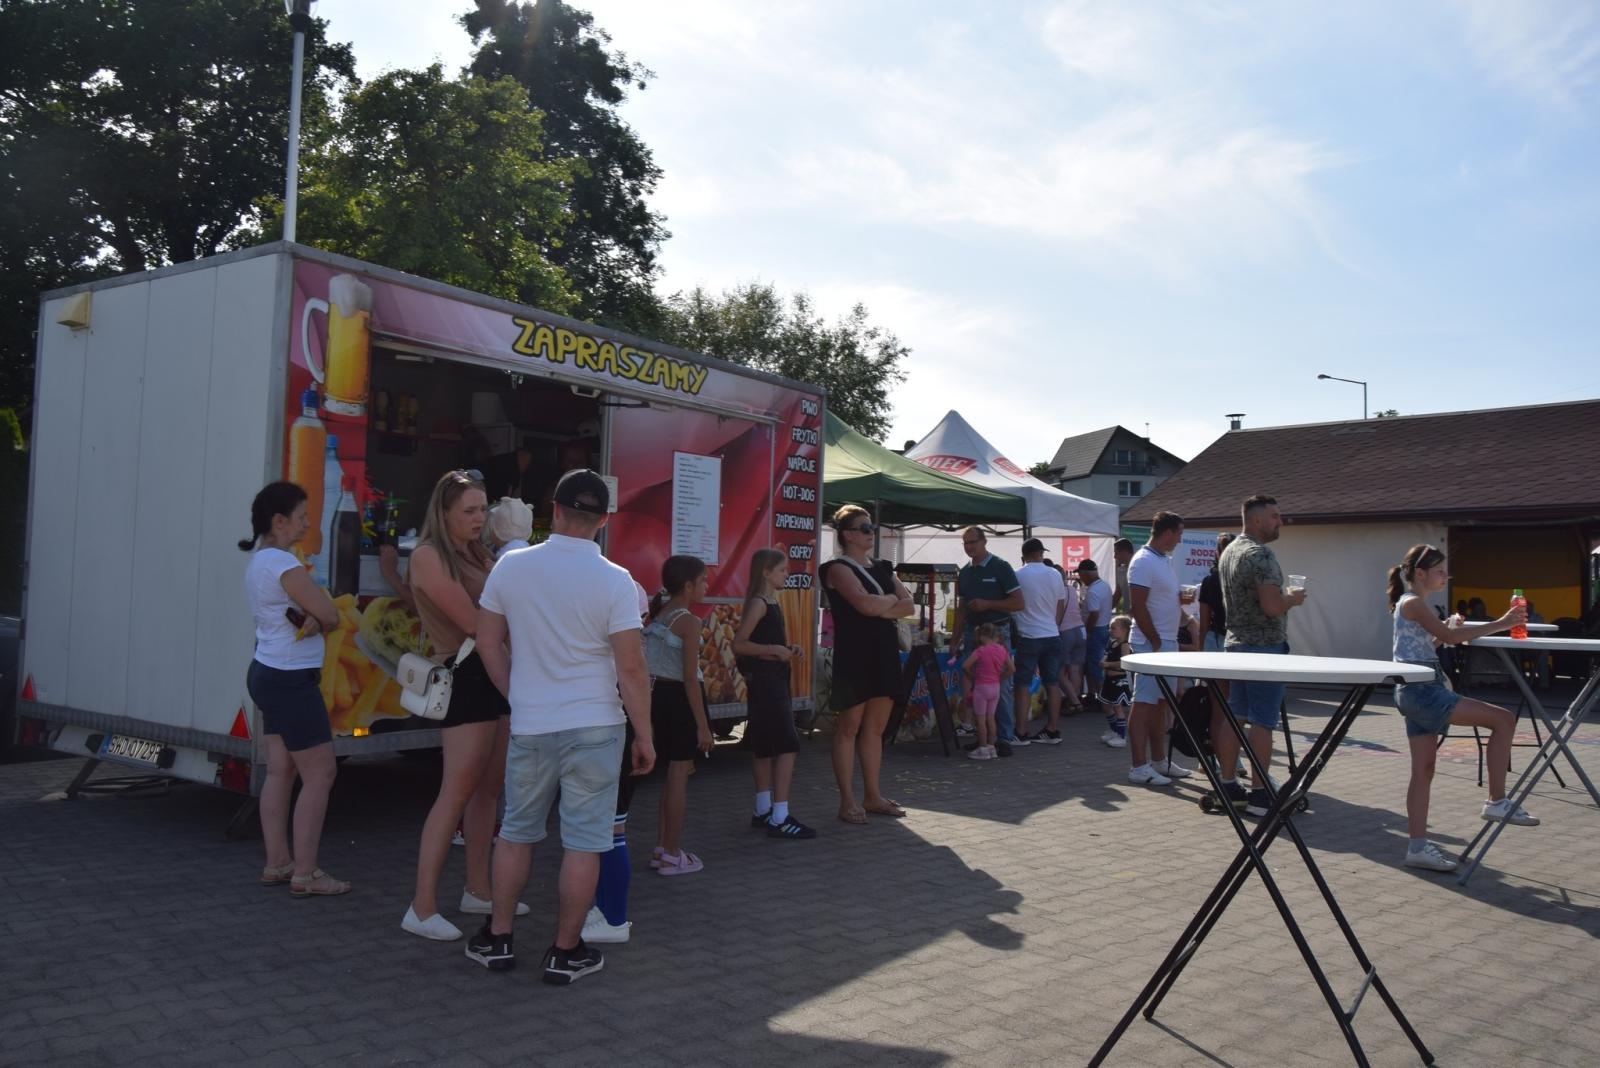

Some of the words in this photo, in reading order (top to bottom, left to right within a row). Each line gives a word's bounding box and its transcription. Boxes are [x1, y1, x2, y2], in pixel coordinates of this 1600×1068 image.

[512, 315, 708, 395] ZAPRASZAMY
[801, 399, 818, 416] PIWO
[791, 427, 818, 446] FRYTKI
[787, 456, 816, 473] NAPOJE
[782, 485, 815, 502] HOT-DOG
[789, 545, 813, 560] GOFRY
[1191, 549, 1217, 557] RODZ
